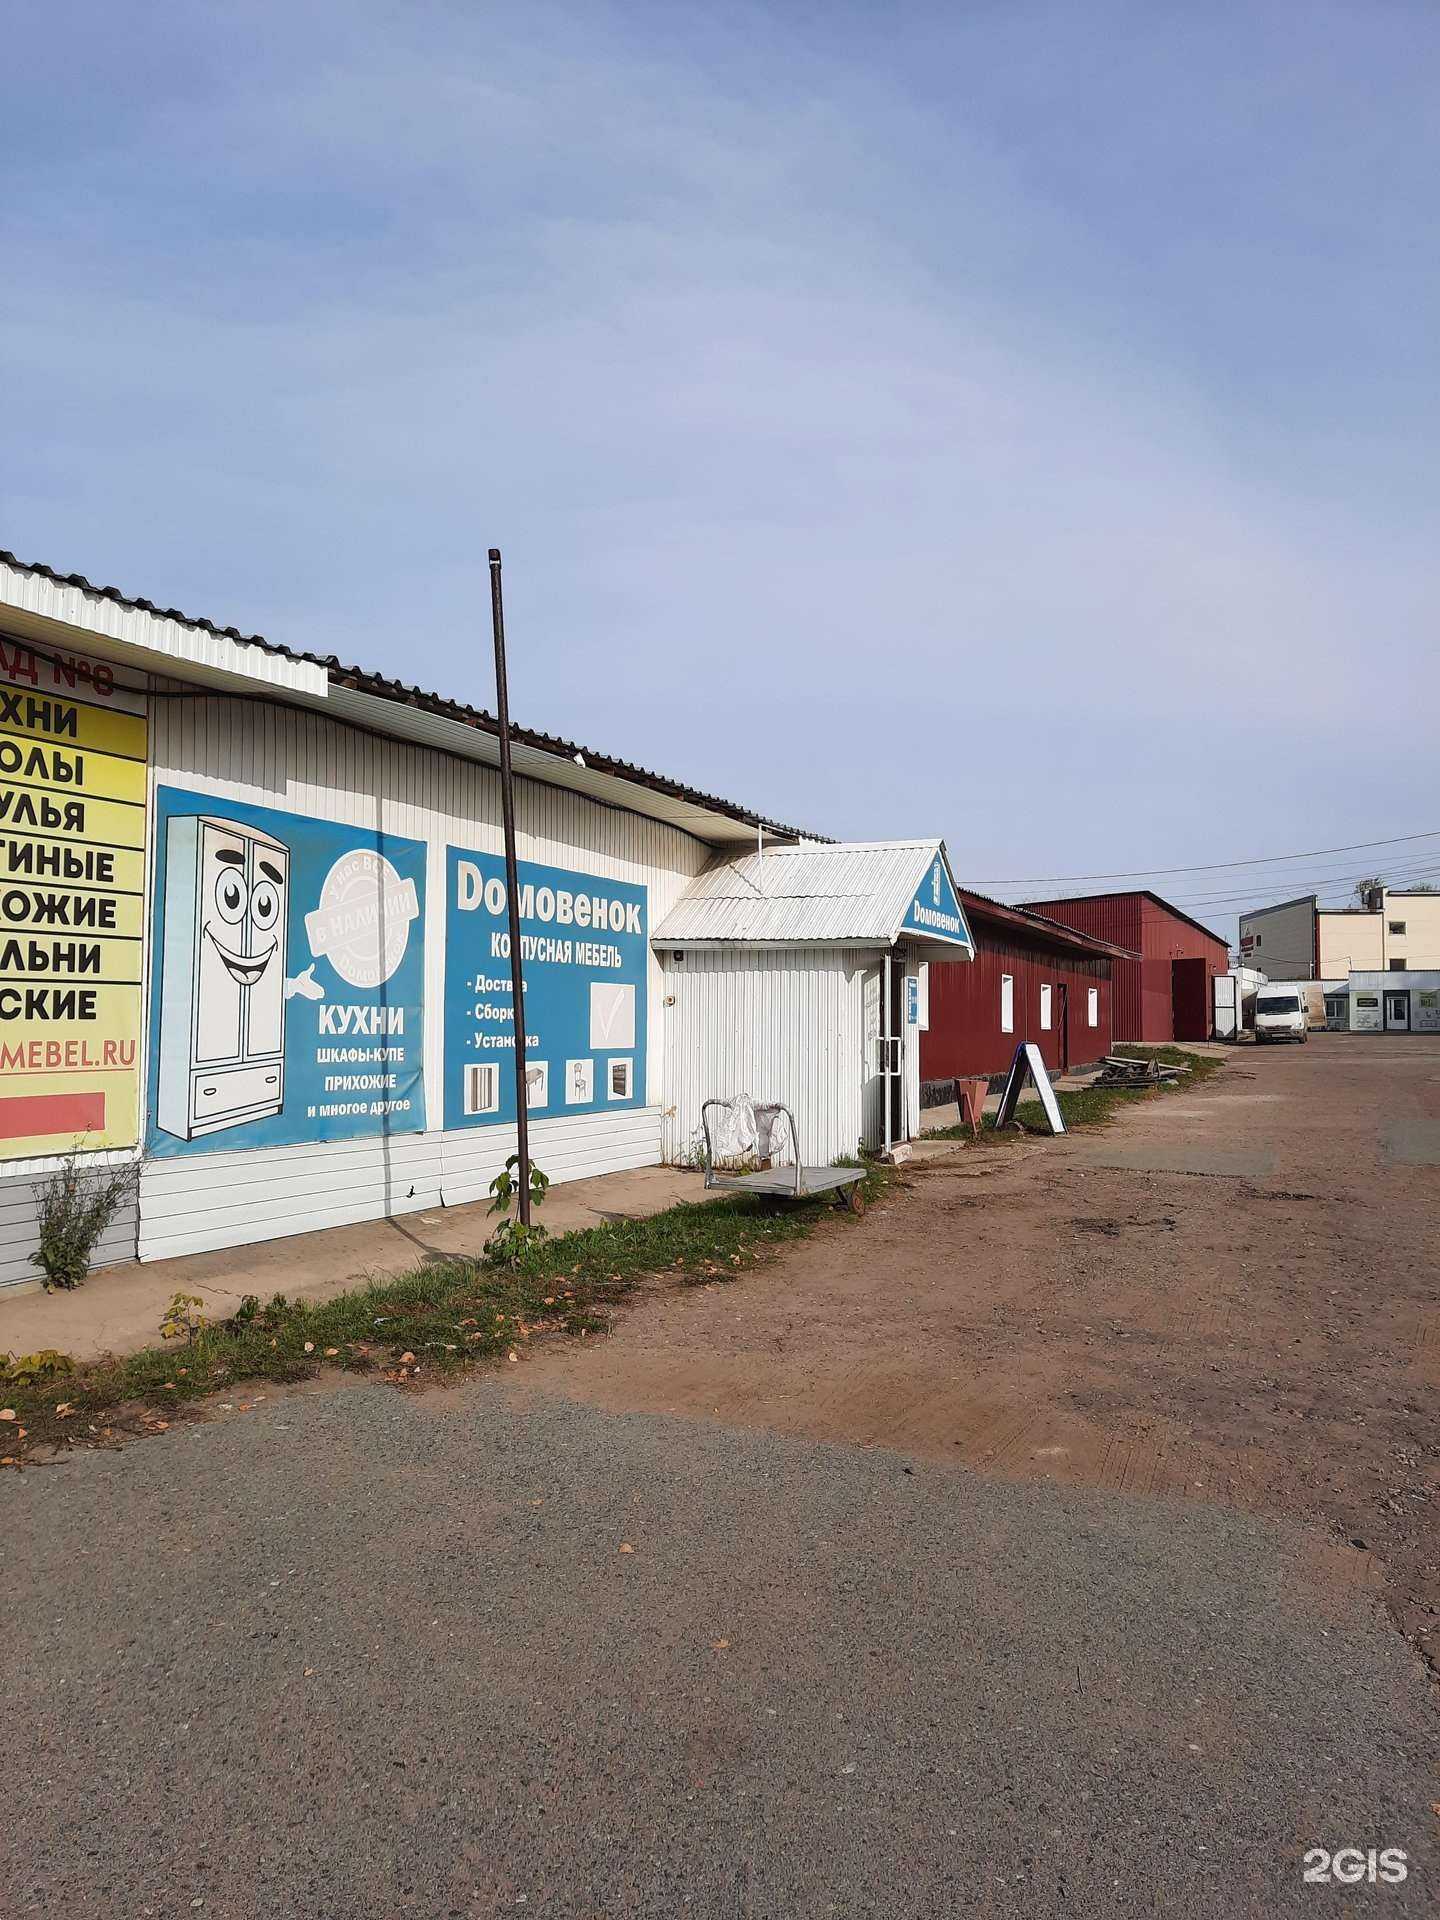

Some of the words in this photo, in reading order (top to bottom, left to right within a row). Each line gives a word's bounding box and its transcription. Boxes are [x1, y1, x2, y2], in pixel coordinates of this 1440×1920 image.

[0, 741, 84, 786] ОЛЫ
[0, 889, 117, 929] ОЖИЕ
[491, 931, 572, 965] КОПУСНАЯ
[575, 941, 622, 969] МЕБЕЛЬ
[318, 1004, 404, 1035] КУХНИ
[474, 1003, 515, 1024] Сборк
[474, 1031, 540, 1049] Устанка
[317, 1047, 405, 1063] ШКАФЫ-КУПЕ
[325, 1073, 397, 1092] ПРИХОЖИЕ
[307, 1105, 316, 1118] и
[319, 1102, 368, 1117] многое
[370, 1099, 411, 1116] другое
